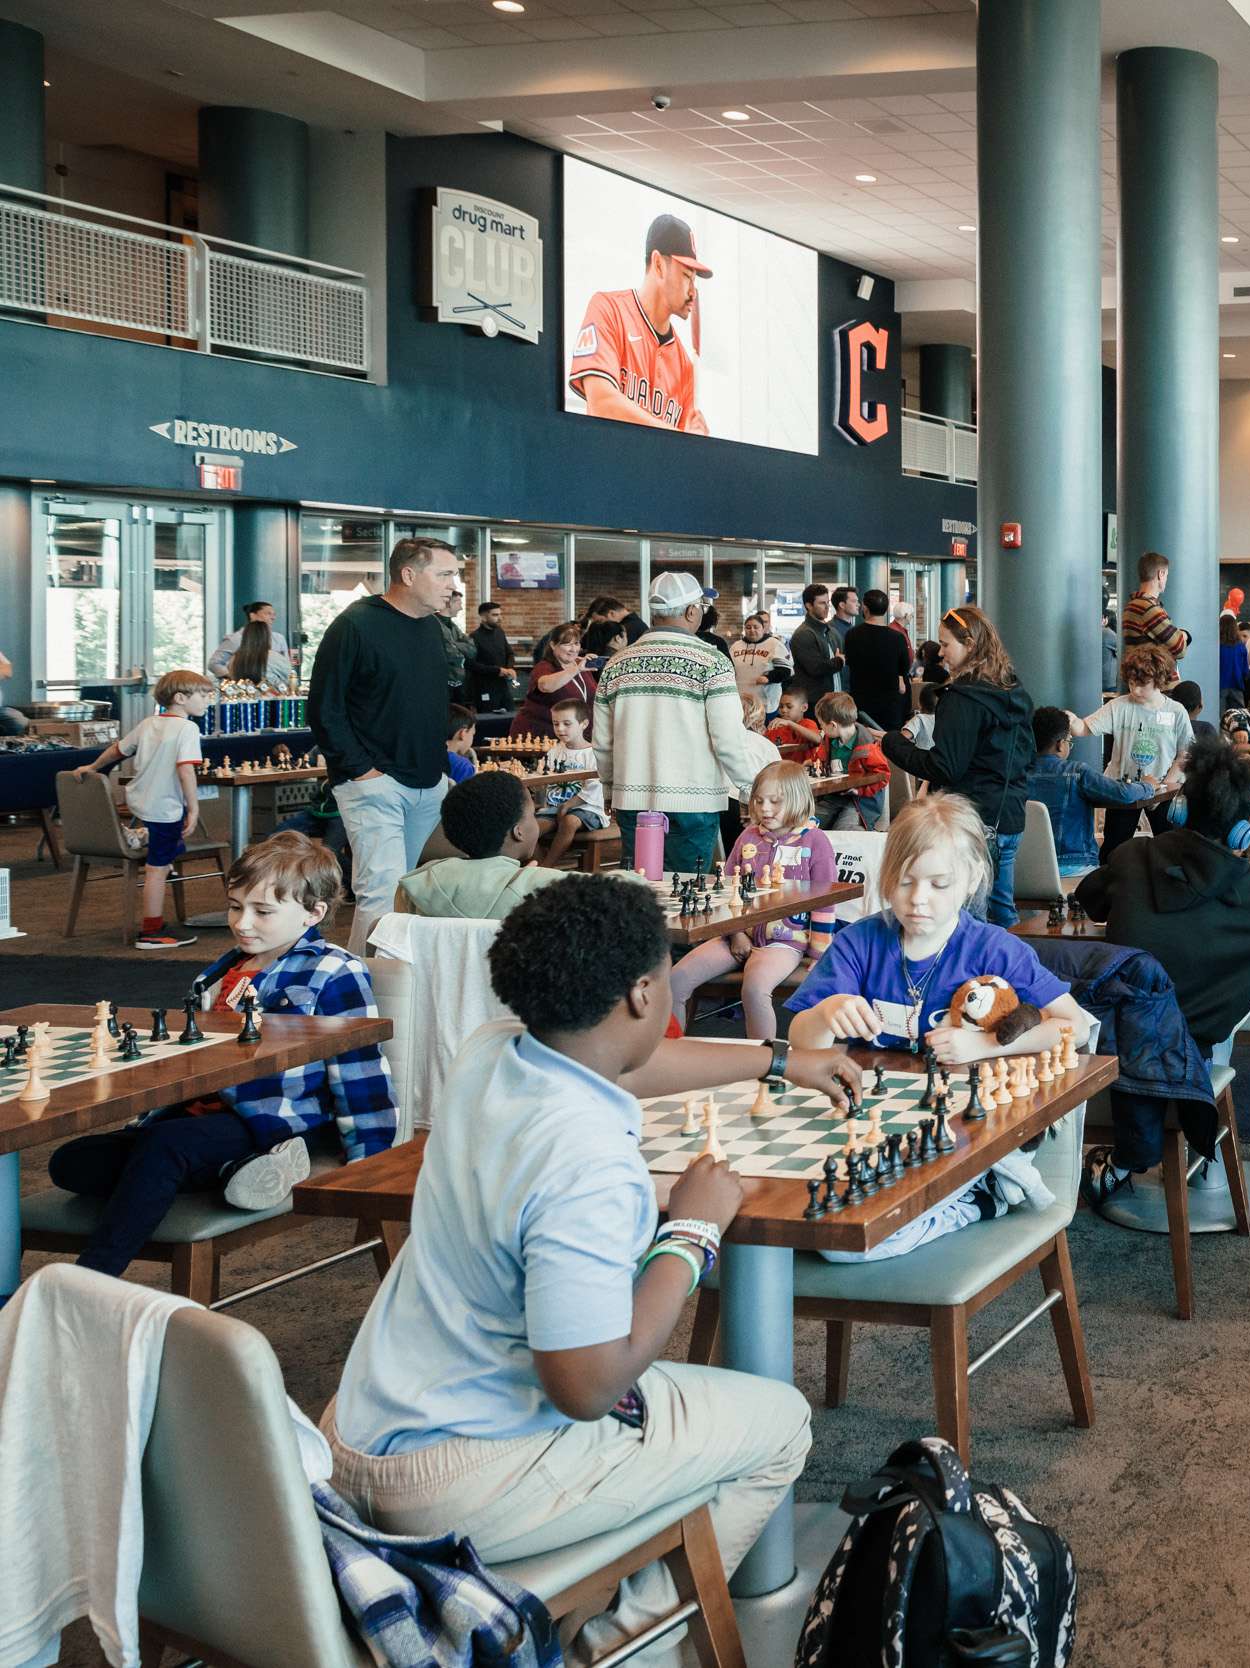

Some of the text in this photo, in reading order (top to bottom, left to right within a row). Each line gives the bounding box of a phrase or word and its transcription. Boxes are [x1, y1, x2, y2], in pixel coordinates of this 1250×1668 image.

[452, 205, 526, 240] drug mart
[473, 205, 505, 220] DISCOUNT
[440, 224, 538, 305] CLUB
[174, 419, 278, 455] RESTROOMS
